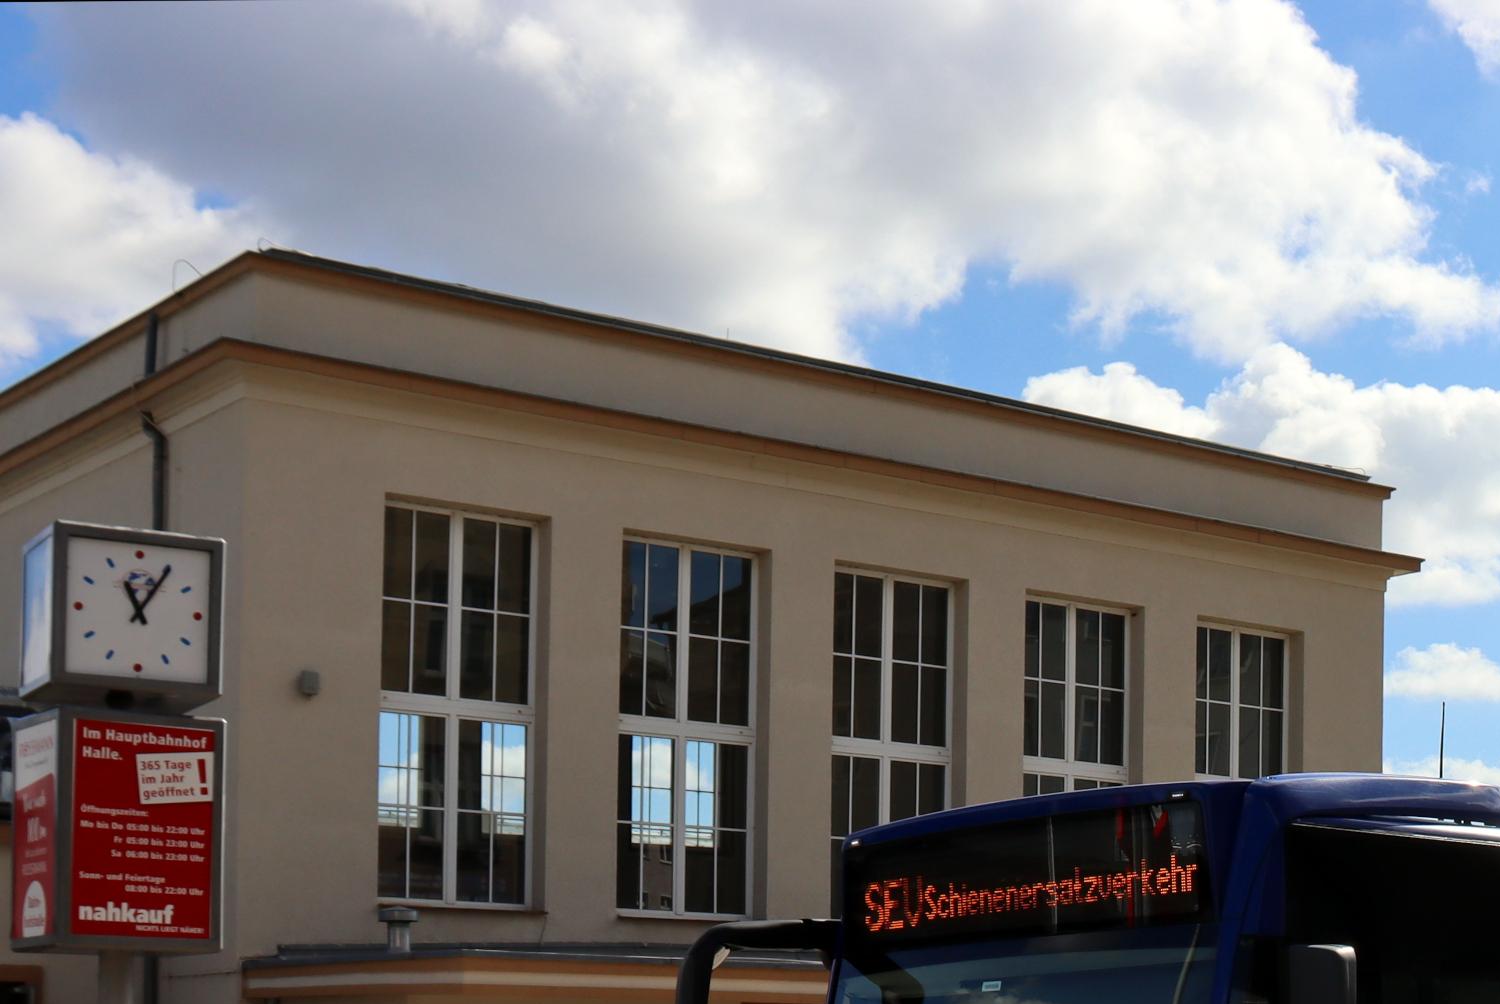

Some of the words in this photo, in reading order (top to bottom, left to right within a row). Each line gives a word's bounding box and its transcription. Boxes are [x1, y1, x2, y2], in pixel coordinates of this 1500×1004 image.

[83, 727, 101, 739] Im
[106, 729, 207, 749] Hauptbahnhof
[82, 745, 123, 760] Halle.
[140, 760, 160, 770] 365
[164, 760, 192, 772] Tage
[142, 775, 156, 784] im
[160, 773, 184, 784] Jahr
[143, 787, 195, 800] geöffnet
[80, 820, 94, 828] Mo
[96, 821, 109, 829] bis
[112, 822, 124, 830] Do
[151, 824, 164, 833] bis
[190, 828, 205, 836] Uhr
[151, 838, 164, 846] bis
[190, 841, 205, 849] Uhr
[111, 849, 122, 858] Sa
[151, 852, 163, 860] bis
[190, 854, 204, 862] Uhr
[79, 871, 104, 879] Sonn-
[106, 872, 122, 880] und
[125, 874, 165, 884] Feiertage
[150, 886, 162, 894] bis
[189, 888, 204, 896] Uhr
[864, 875, 923, 932] SEV
[924, 852, 1198, 920] Schienenersatzverkehr
[78, 900, 174, 924] nahkauf
